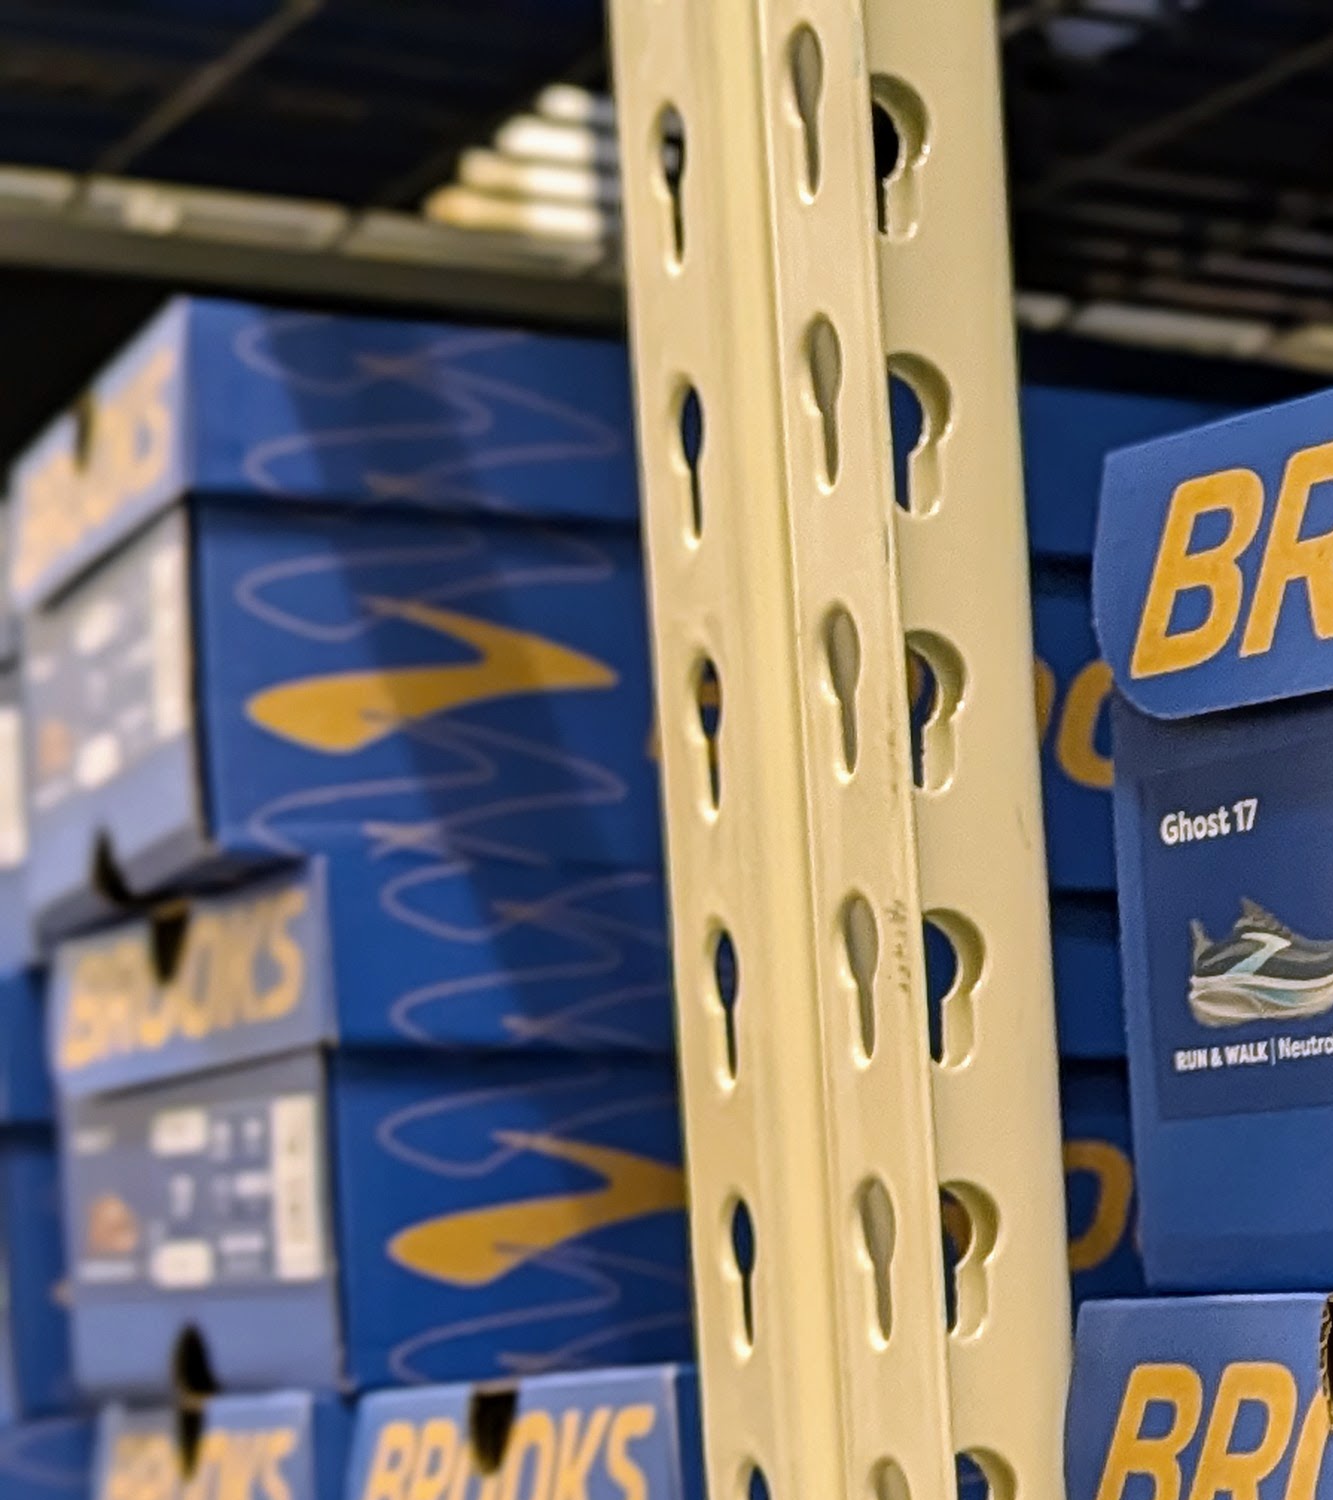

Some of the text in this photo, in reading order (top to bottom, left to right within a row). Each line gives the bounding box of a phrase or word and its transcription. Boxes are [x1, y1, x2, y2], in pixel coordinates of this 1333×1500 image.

[1160, 798, 1258, 845] Ghost 17
[1174, 1049, 1208, 1072] RUN
[1210, 1047, 1223, 1068] &
[1225, 1041, 1268, 1065] WALK
